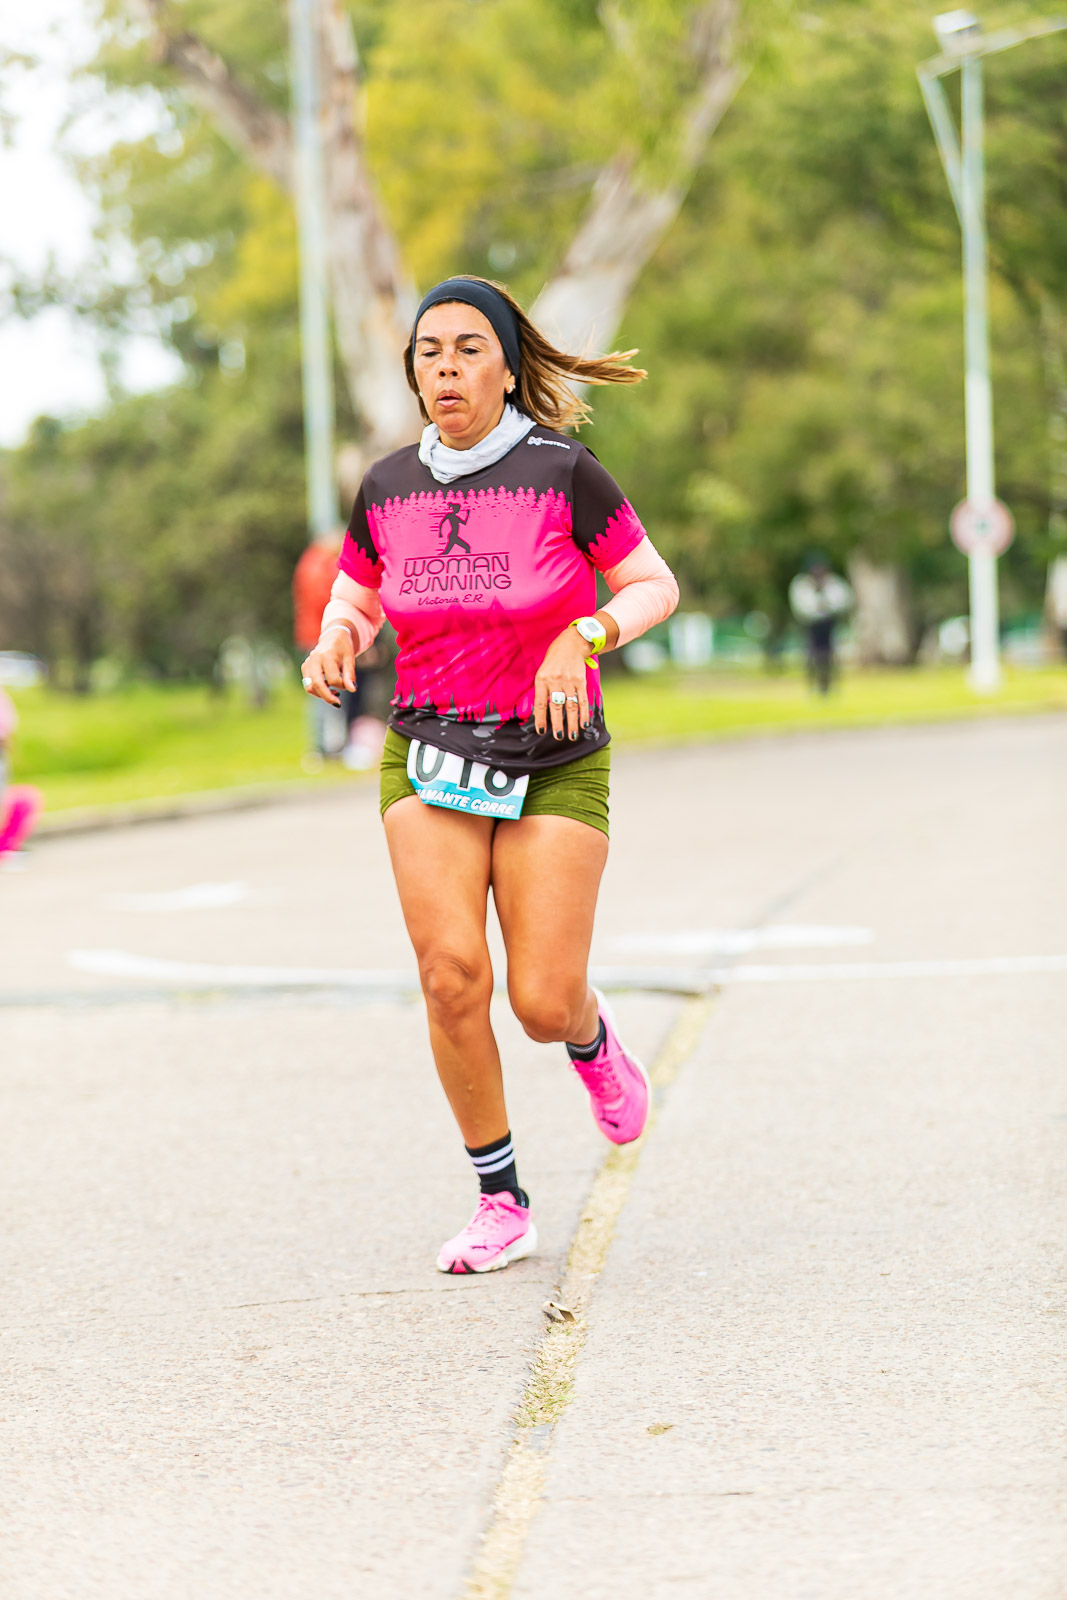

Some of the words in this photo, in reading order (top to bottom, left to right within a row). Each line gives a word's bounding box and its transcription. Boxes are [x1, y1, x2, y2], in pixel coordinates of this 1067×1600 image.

[403, 555, 509, 578] WOMAN
[399, 573, 512, 596] RUNNING
[418, 596, 459, 605] Victoria
[462, 594, 485, 603] E.R.
[470, 798, 516, 815] CORRE
